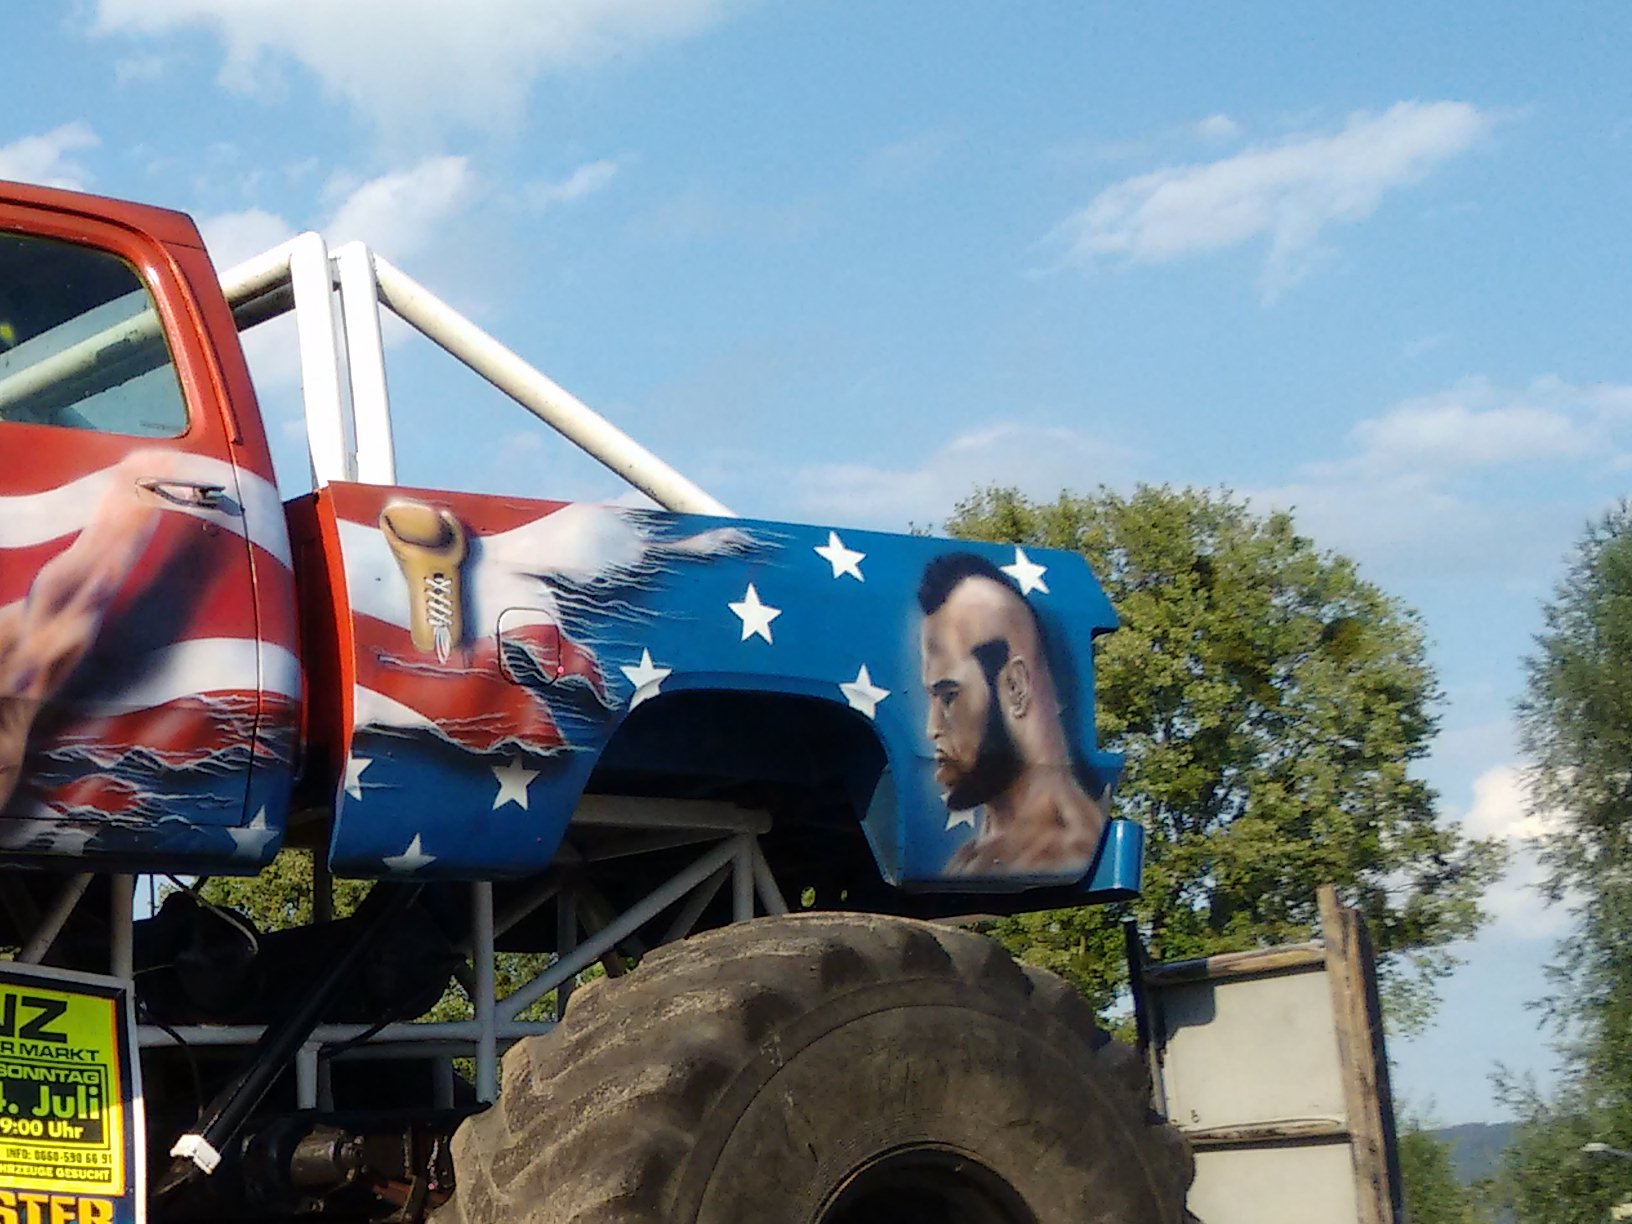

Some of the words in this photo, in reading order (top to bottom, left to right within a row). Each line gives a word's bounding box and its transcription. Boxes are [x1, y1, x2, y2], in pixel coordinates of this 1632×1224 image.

[20, 1043, 100, 1061] MARKT
[32, 1084, 100, 1119] Juli
[48, 1120, 85, 1140] Uhr
[55, 1167, 110, 1181] GESUCHT
